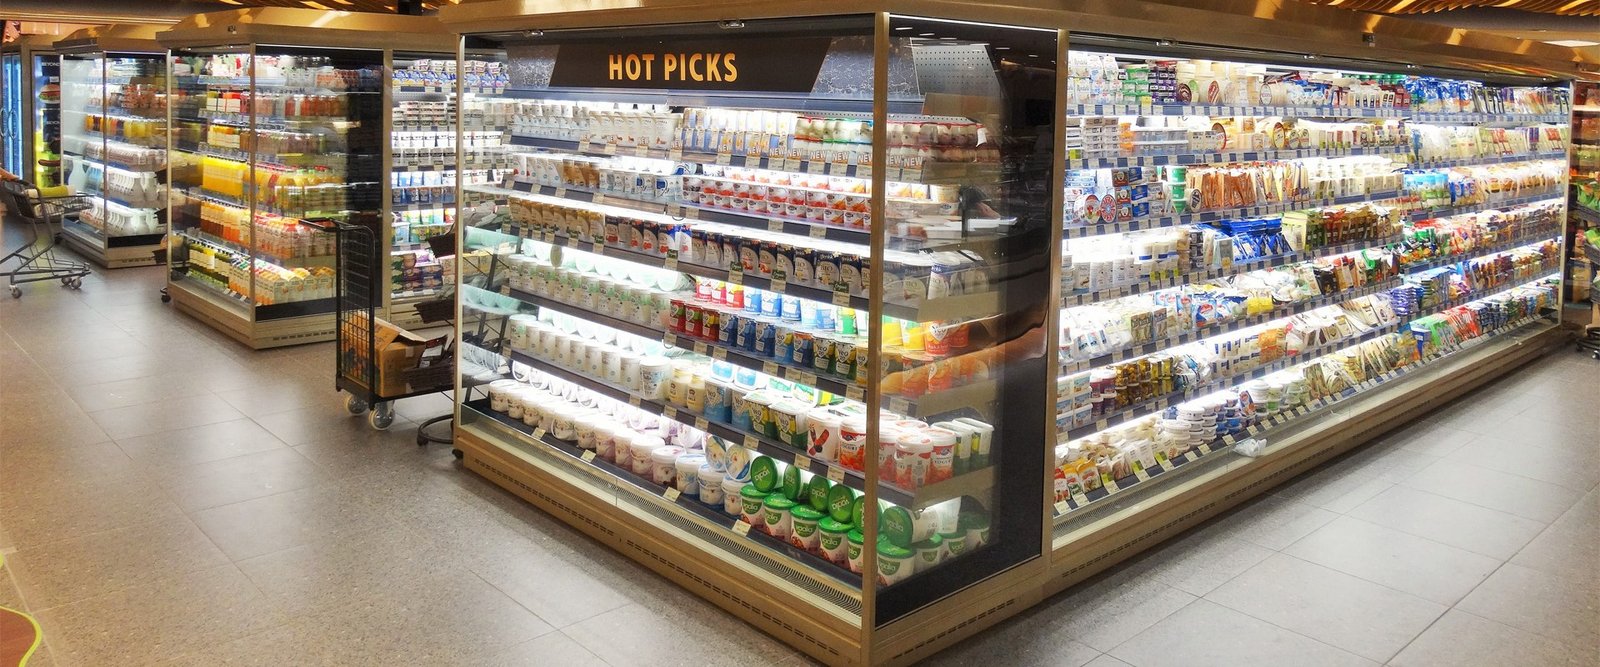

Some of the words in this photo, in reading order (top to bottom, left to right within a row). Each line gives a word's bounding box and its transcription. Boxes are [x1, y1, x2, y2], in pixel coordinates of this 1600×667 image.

[608, 54, 655, 81] HOT
[664, 53, 738, 82] PICKS
[748, 145, 761, 154] NEW
[769, 147, 784, 157] NEW
[786, 148, 801, 159] NEW
[810, 150, 826, 160] NEW
[832, 151, 849, 161] NEW
[903, 156, 923, 167] NEW
